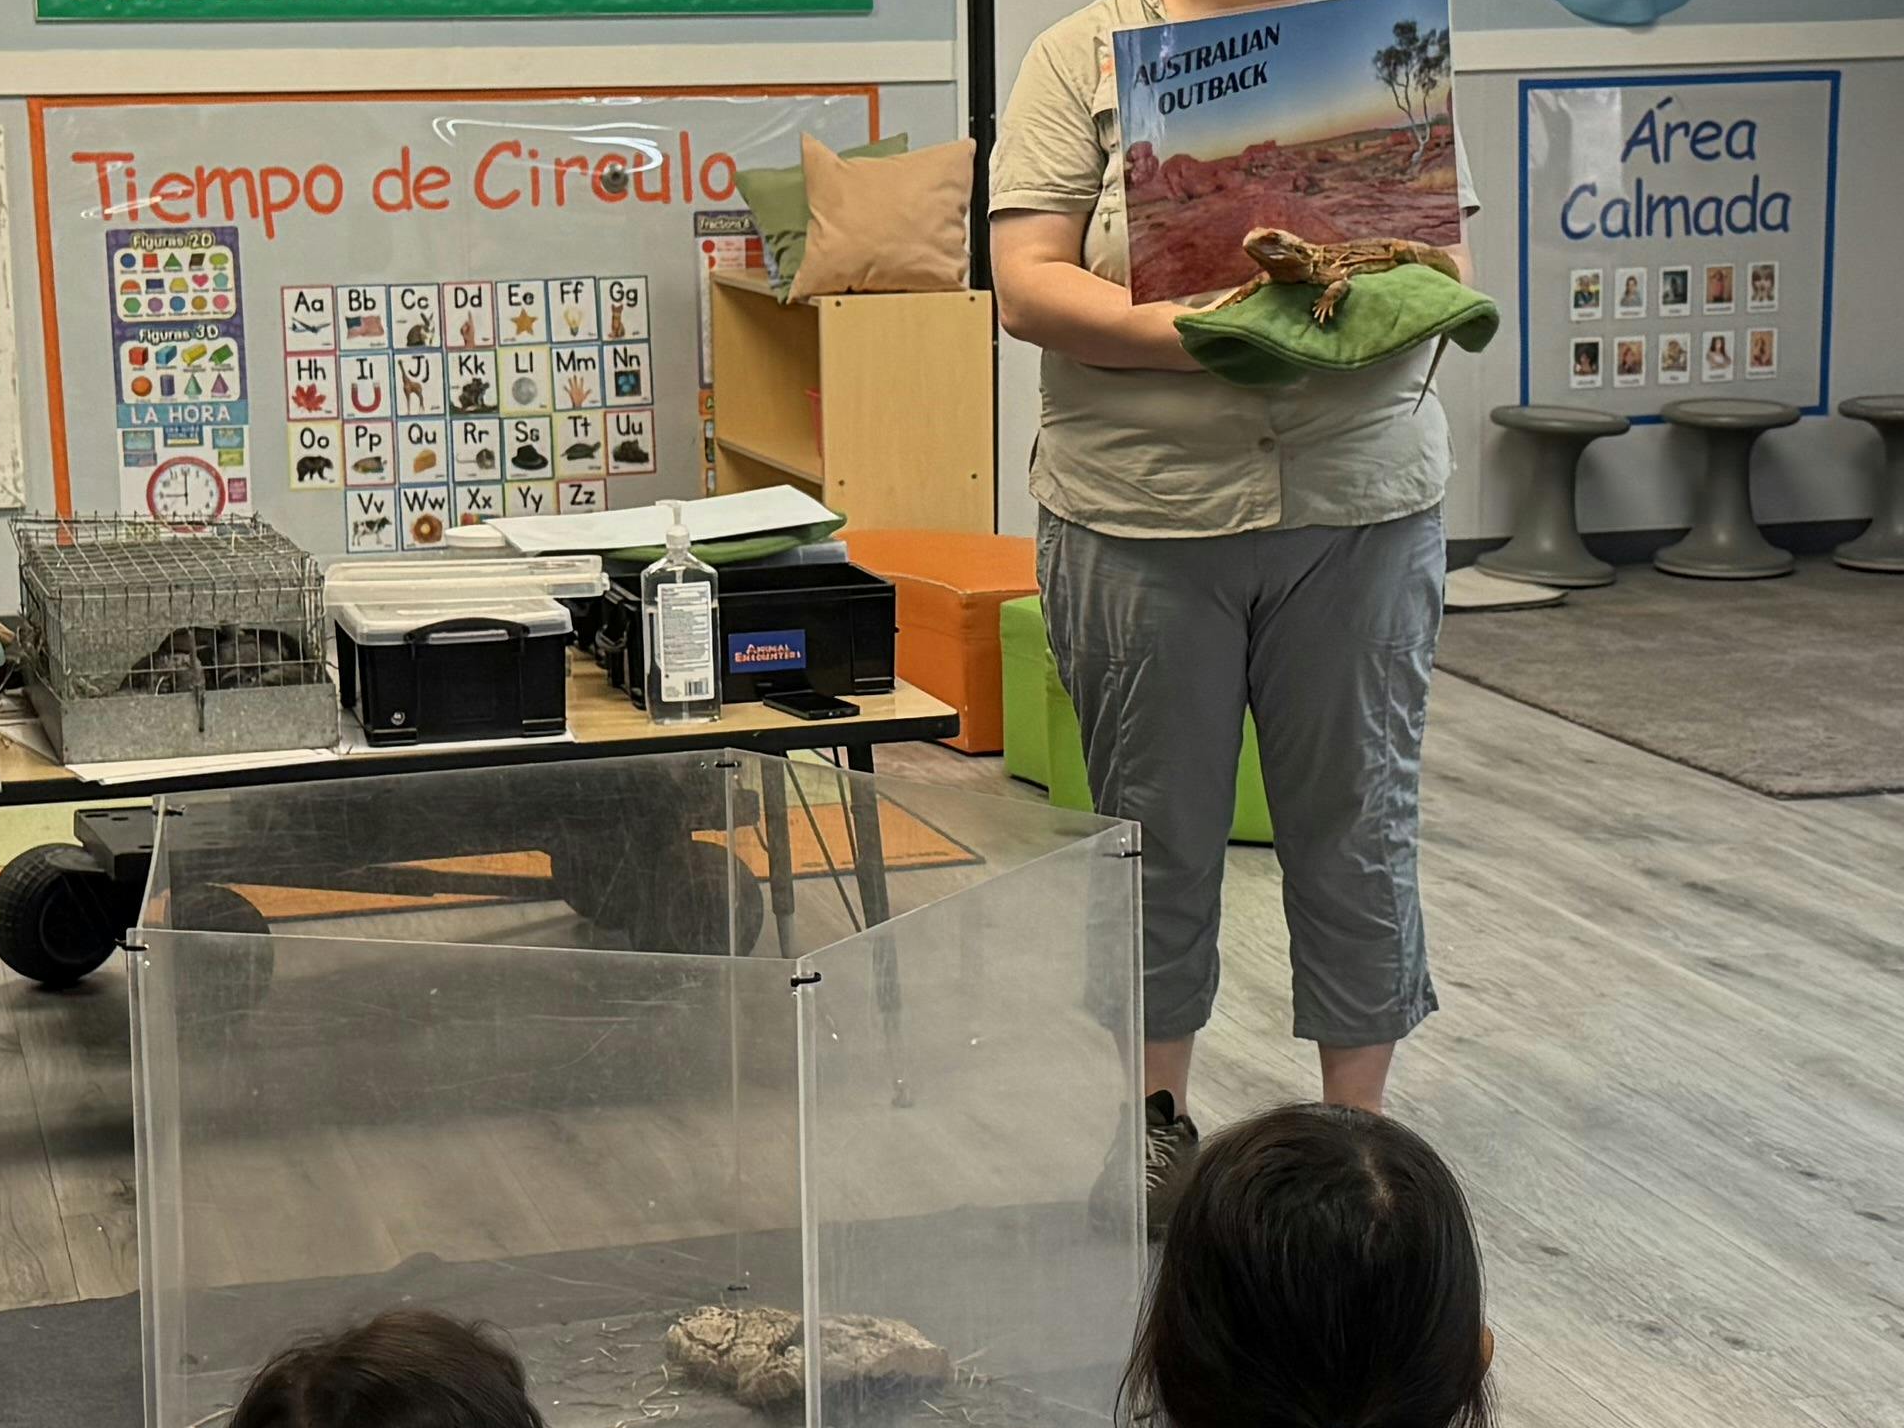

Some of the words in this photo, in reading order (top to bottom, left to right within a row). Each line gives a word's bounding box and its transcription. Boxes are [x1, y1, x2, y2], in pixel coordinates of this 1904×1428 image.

[1132, 22, 1282, 87] AUSTRALIAN
[1157, 59, 1269, 116] OUTBACK
[1620, 96, 1758, 165] Área
[71, 152, 344, 240] Tiempo
[372, 145, 451, 212] de
[474, 131, 738, 210] Circulo
[1561, 174, 1792, 241] Calmada
[132, 234, 185, 250] Figuras
[294, 291, 325, 312] Aa
[348, 289, 377, 312] Bb
[401, 288, 429, 310] Cc
[454, 285, 482, 309] Dd
[507, 283, 535, 307] Ee
[559, 281, 585, 304] Ff
[609, 281, 639, 307] Gg
[139, 328, 192, 345] Figuras
[195, 324, 219, 339] 3D
[408, 355, 430, 383] Jj
[458, 355, 486, 376] Kk
[515, 352, 534, 373] Ll
[556, 350, 596, 373] Mm
[612, 346, 641, 369] Nn
[297, 358, 326, 381] Hh
[130, 405, 159, 424] LA
[168, 405, 231, 424] HORA
[615, 414, 643, 437] Uu
[300, 427, 330, 449] Oo
[408, 423, 437, 445] Qu
[463, 422, 490, 445] Rr
[514, 421, 540, 443] Ss
[567, 415, 592, 438] Tt
[354, 425, 382, 452] Pp
[357, 492, 385, 515] Vv
[403, 490, 446, 512] Ww
[467, 487, 492, 510] Xx
[518, 486, 543, 513] Yy
[569, 483, 596, 506] Zz
